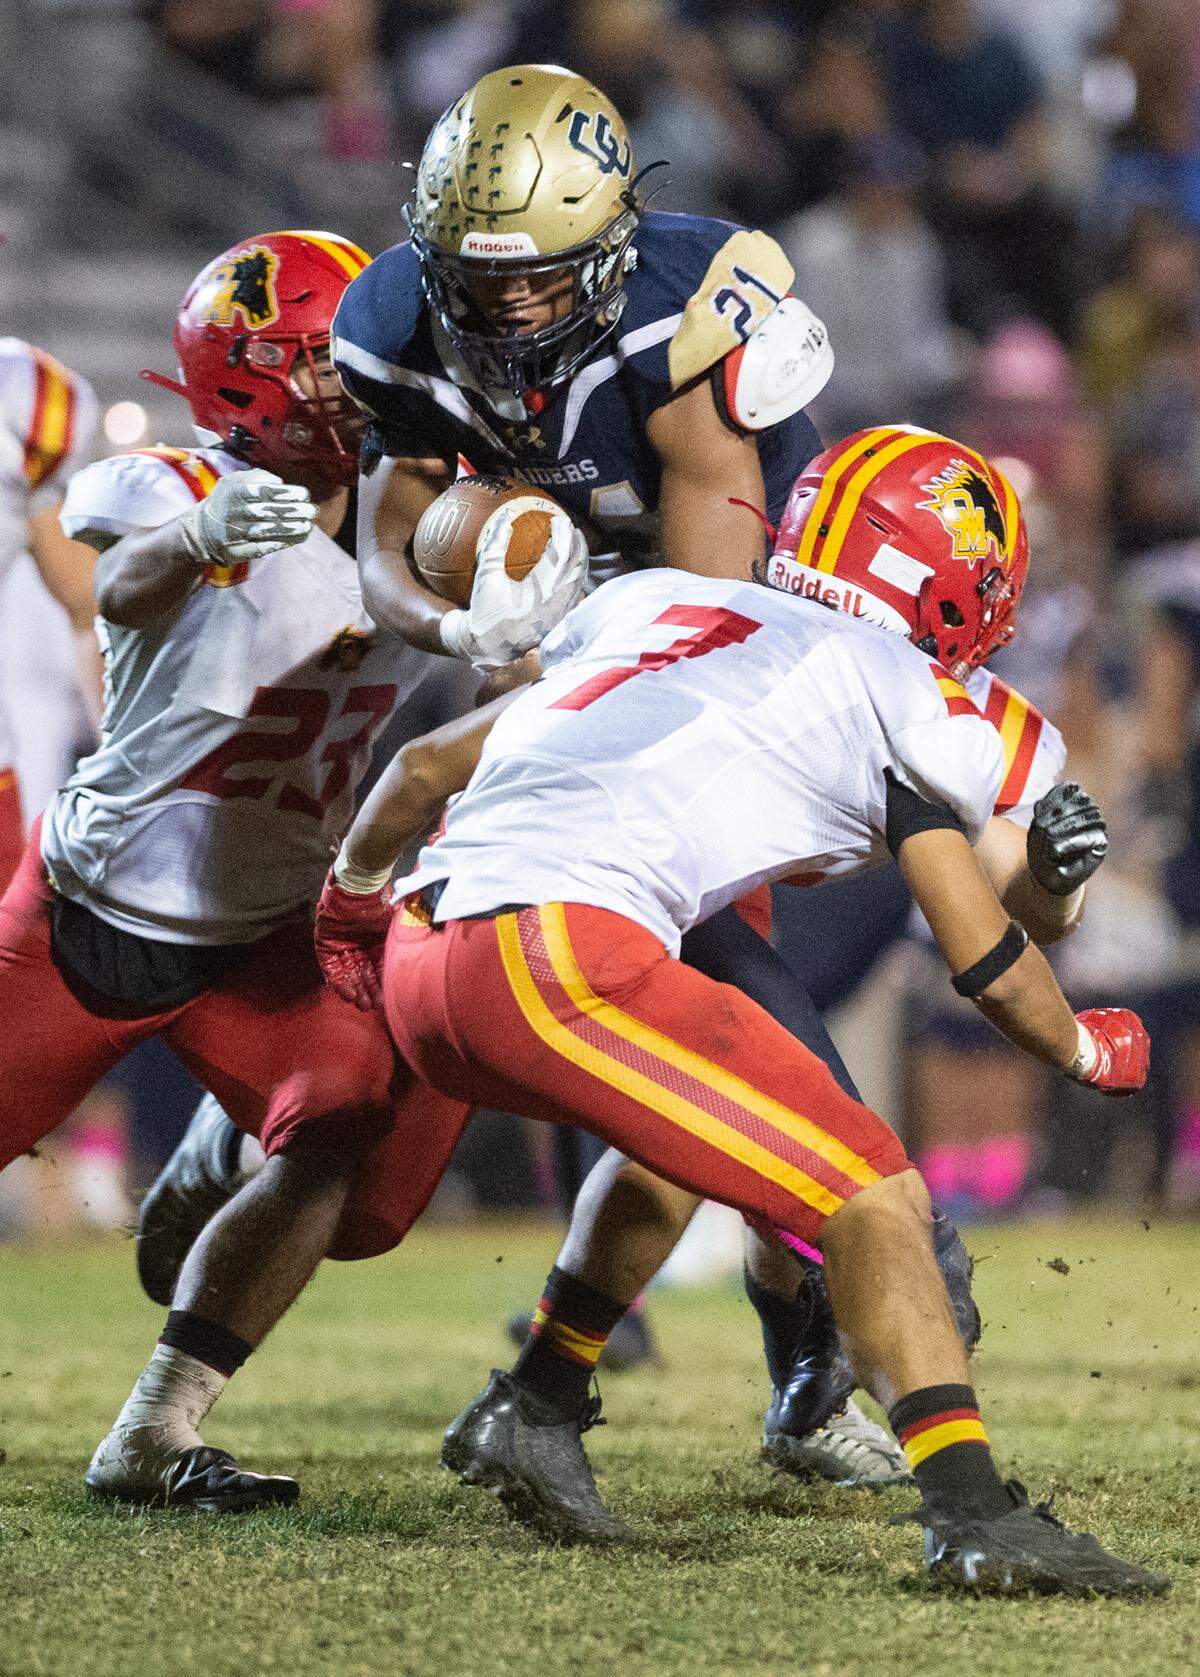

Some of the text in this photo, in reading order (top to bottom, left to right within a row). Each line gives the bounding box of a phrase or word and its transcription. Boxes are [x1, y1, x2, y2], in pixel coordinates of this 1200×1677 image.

[713, 266, 781, 343] 21
[772, 561, 864, 618] Riddell
[545, 603, 765, 712] 7
[177, 682, 398, 821] 23
